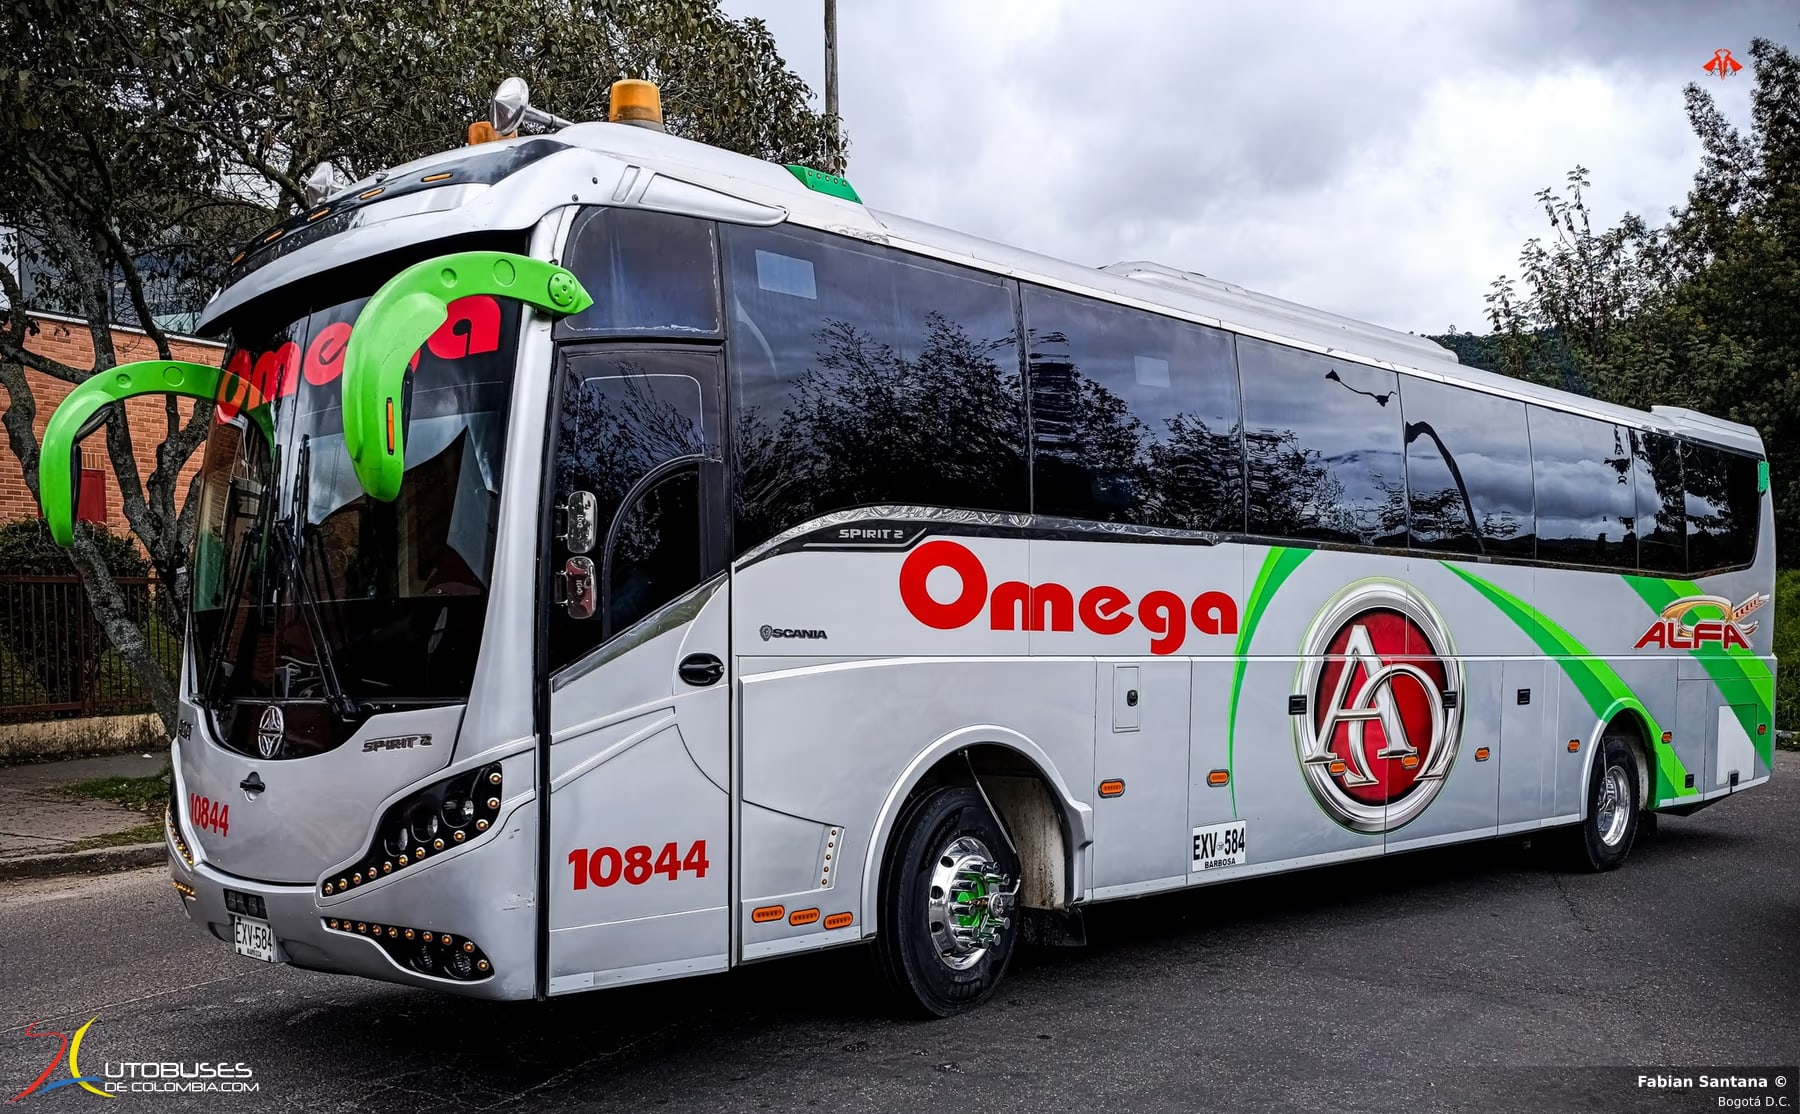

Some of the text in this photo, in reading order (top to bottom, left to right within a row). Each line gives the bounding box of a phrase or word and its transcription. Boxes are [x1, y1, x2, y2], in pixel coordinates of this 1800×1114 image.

[838, 528, 904, 539] SPIRIT 2
[899, 540, 1238, 655] Omega
[772, 628, 828, 640] SCANIA
[1632, 620, 1751, 650] ALFA
[362, 735, 432, 752] SPIRIT 2
[190, 793, 229, 837] 10844
[568, 839, 709, 891] 10844
[1204, 857, 1236, 869] BARBOSA
